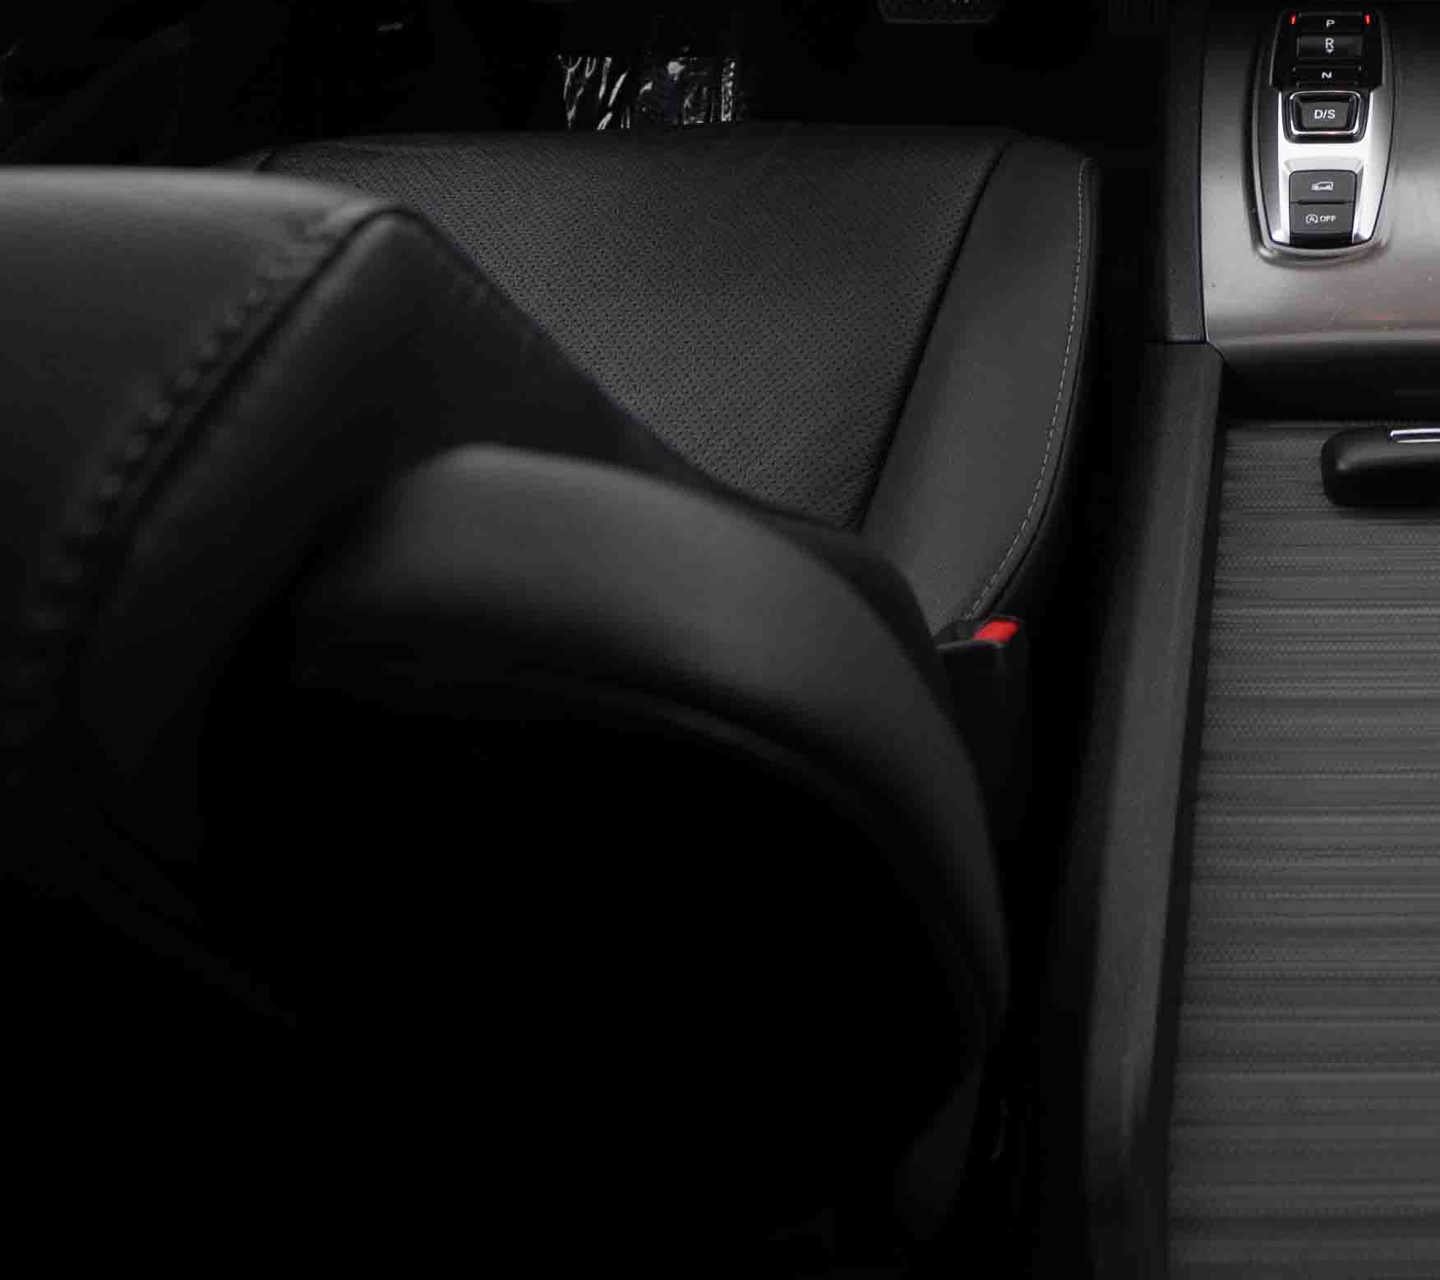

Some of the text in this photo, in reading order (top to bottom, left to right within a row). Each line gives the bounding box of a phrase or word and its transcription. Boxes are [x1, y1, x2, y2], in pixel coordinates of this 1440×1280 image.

[1325, 19, 1335, 28] P
[1325, 37, 1335, 49] R
[1321, 71, 1332, 79] N
[1314, 108, 1335, 120] D/S
[1319, 214, 1336, 223] OFF
